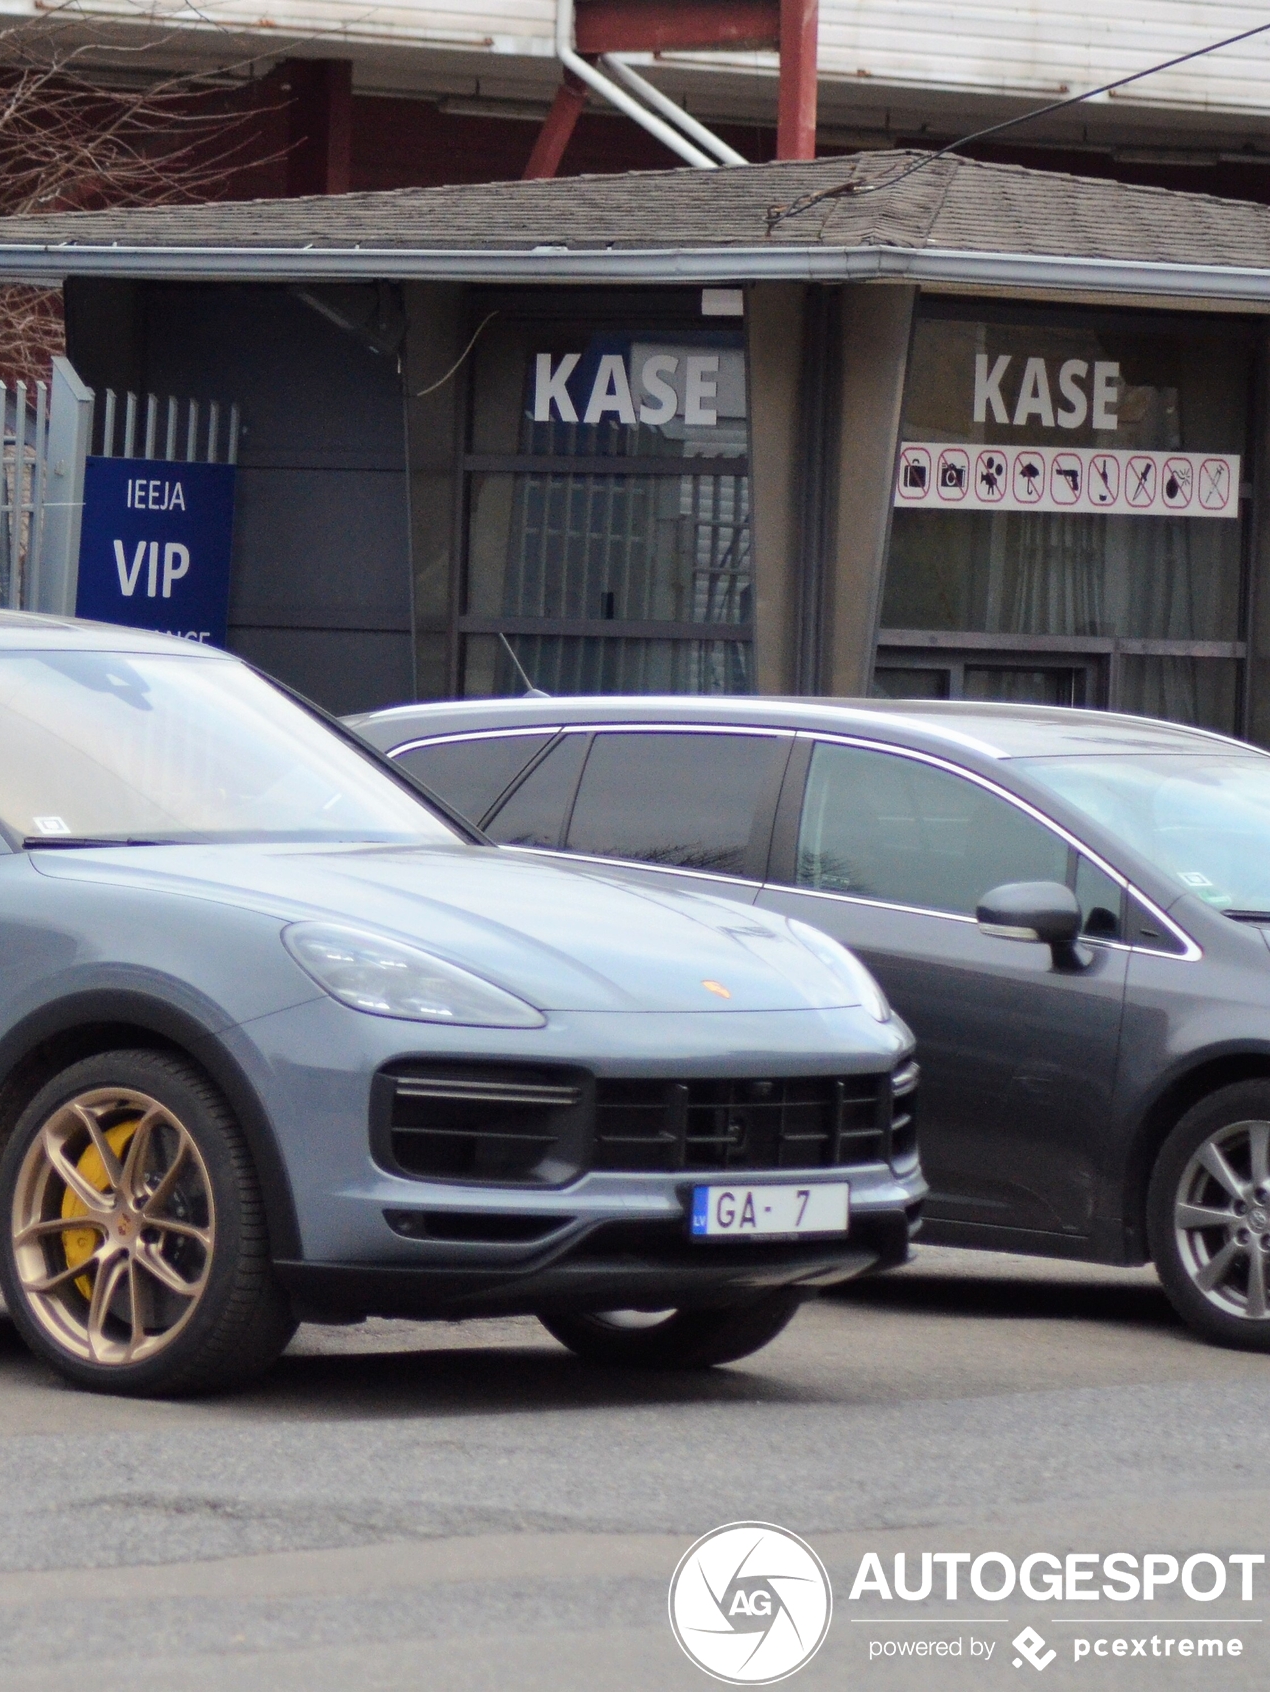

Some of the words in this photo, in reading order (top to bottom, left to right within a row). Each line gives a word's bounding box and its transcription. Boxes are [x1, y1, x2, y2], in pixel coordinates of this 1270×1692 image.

[534, 352, 719, 426] KASE
[973, 353, 1120, 431] KASE
[127, 479, 185, 511] IEEJA
[113, 539, 190, 599] VIP
[693, 1215, 707, 1227] LV
[796, 1190, 810, 1227] 7
